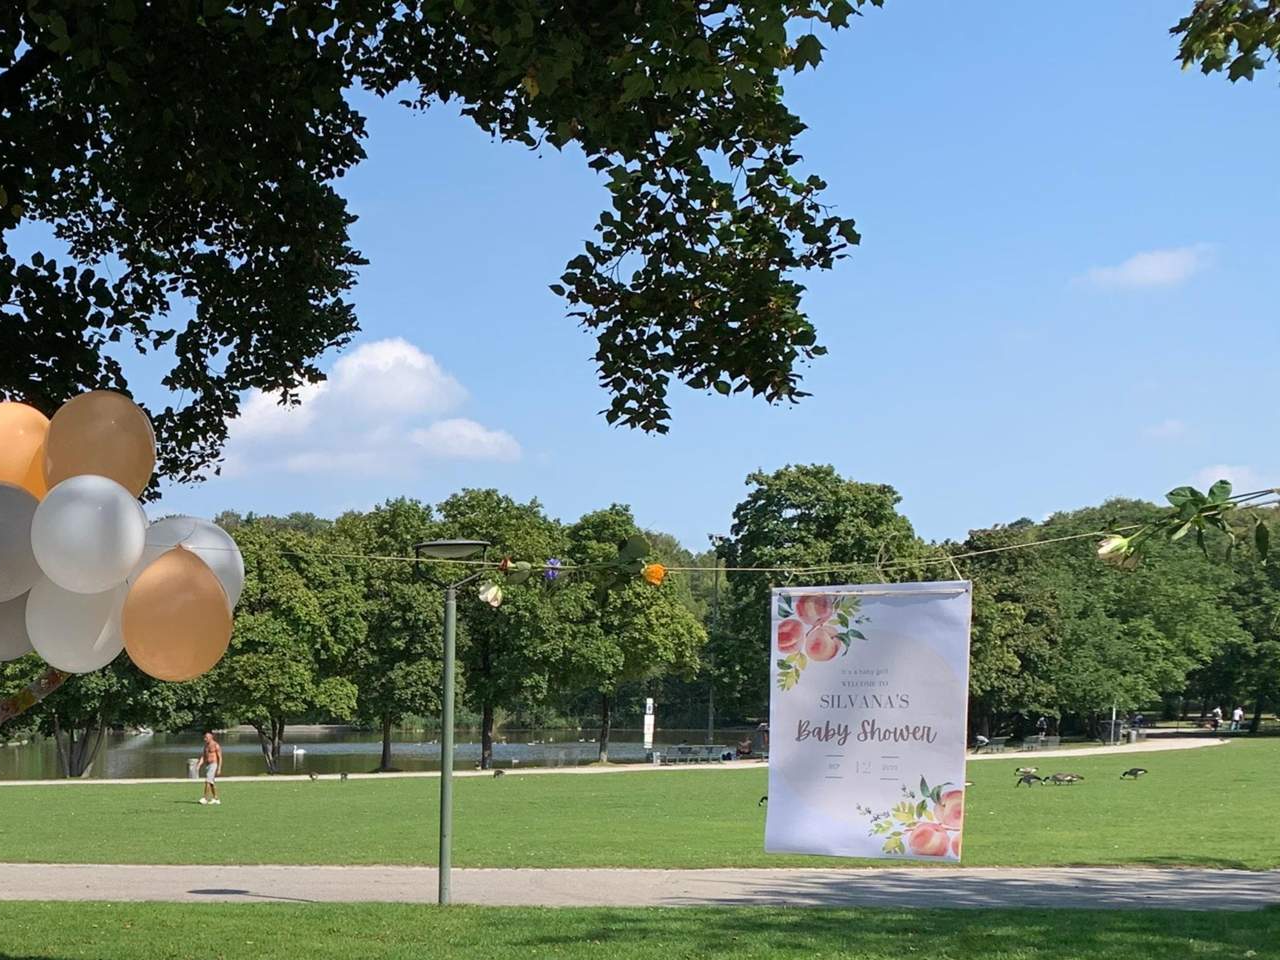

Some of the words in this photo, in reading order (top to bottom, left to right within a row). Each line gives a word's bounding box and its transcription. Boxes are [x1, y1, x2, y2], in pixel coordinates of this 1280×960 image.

[820, 694, 910, 709] SILVANA'S
[795, 719, 851, 746] Baby
[857, 719, 937, 744] Shower
